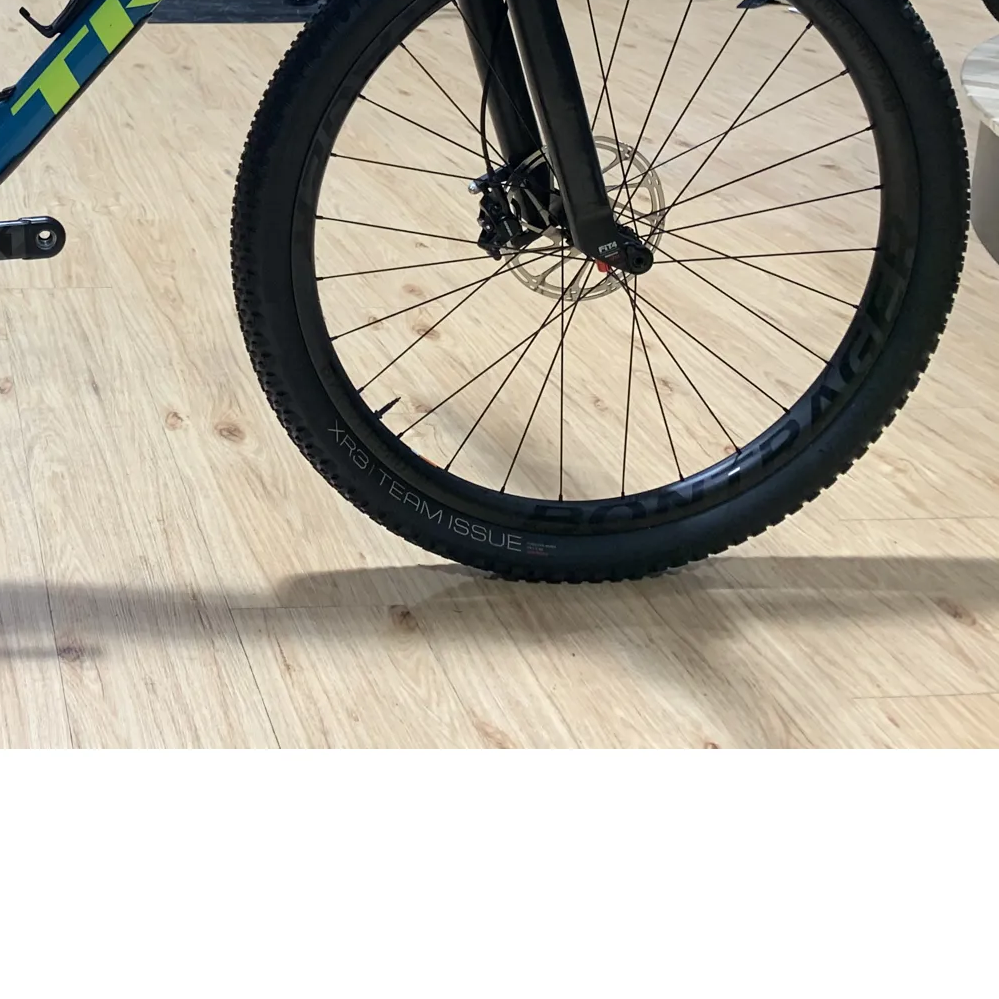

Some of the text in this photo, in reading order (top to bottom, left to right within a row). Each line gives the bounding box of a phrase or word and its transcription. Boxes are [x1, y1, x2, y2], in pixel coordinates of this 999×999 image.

[598, 240, 619, 253] FIT4
[327, 419, 523, 553] XR3 TEAM ISSUE
